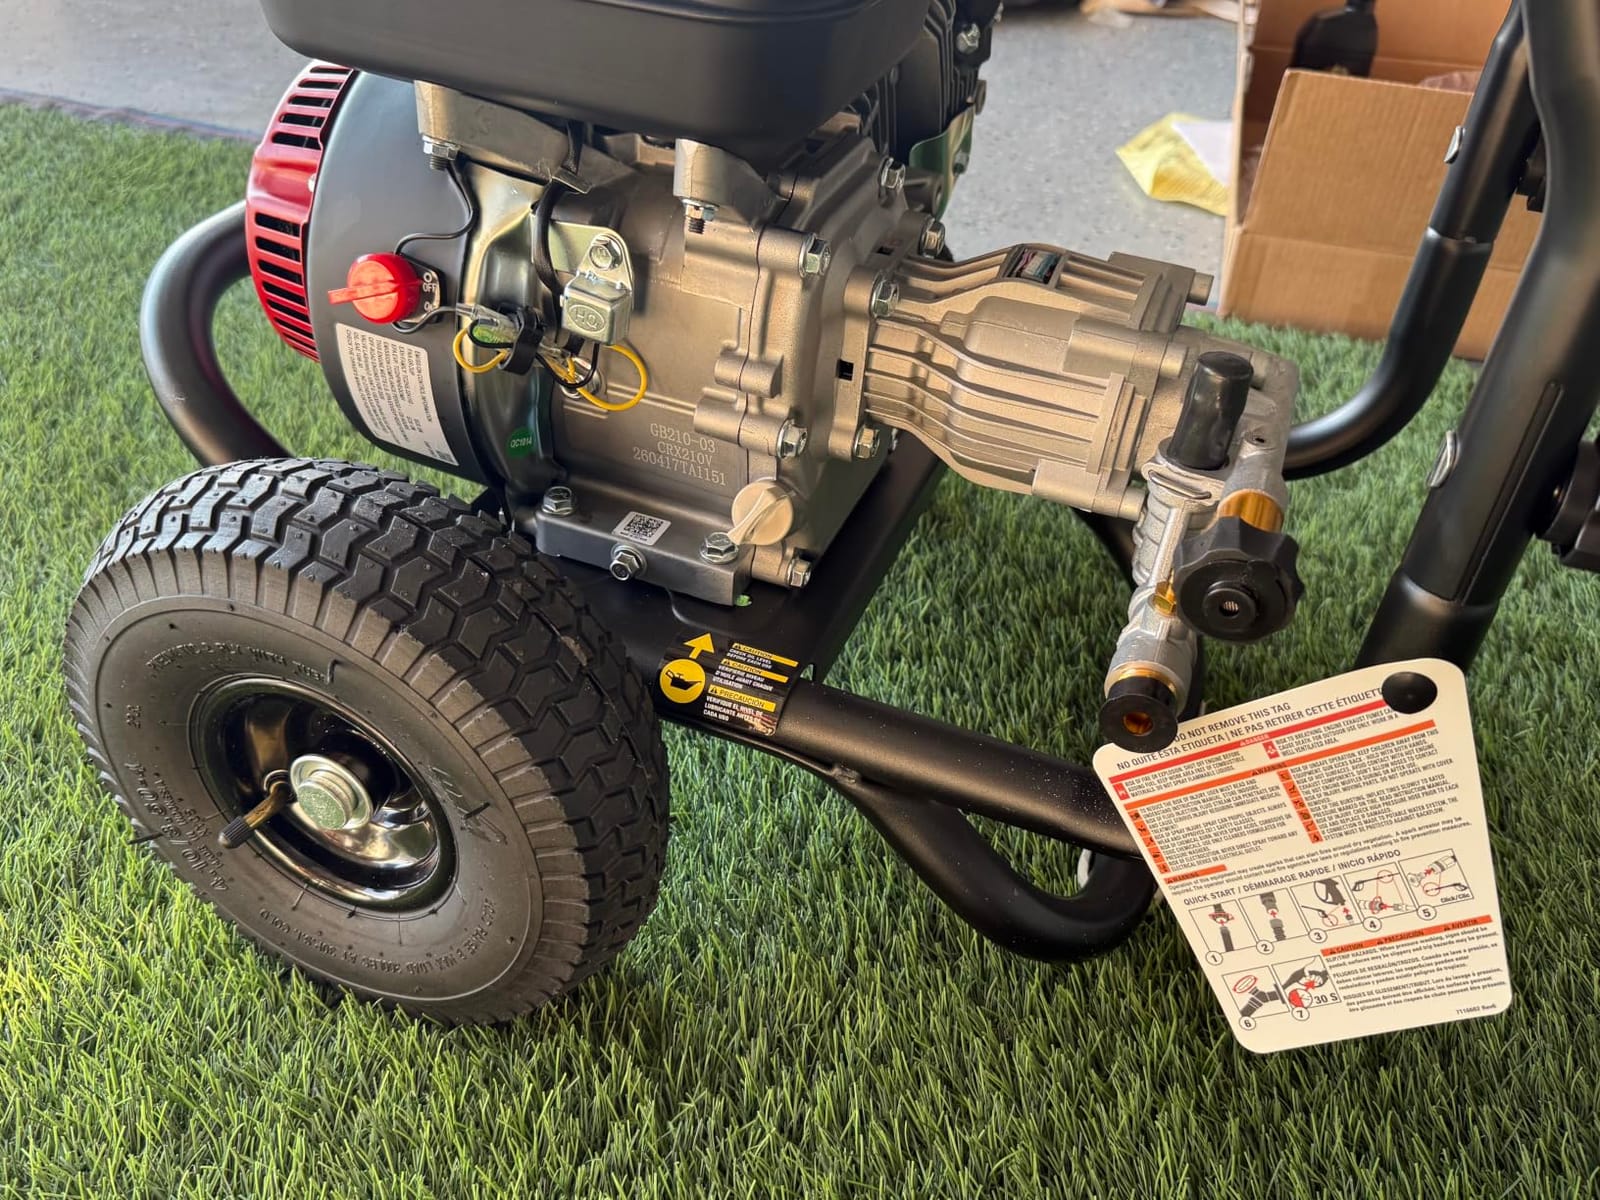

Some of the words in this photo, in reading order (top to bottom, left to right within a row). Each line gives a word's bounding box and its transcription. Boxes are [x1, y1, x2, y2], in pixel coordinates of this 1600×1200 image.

[650, 423, 716, 452] GB210-03
[633, 447, 726, 486] 260417TA1151
[657, 441, 713, 467] CRX210V
[744, 647, 772, 658] CAUTION
[1187, 726, 1207, 738] NOT
[1207, 715, 1246, 732] REMOVE
[1247, 708, 1270, 721] THIS
[1271, 702, 1290, 714] TAG
[1117, 760, 1131, 770] NO
[1130, 753, 1157, 766] QUITE
[1157, 746, 1181, 758] ESTA
[1181, 733, 1224, 751] ETIQUETA
[1230, 728, 1244, 737] NE
[1244, 722, 1264, 733] PAS
[1264, 710, 1304, 727] RETIRER
[1305, 701, 1334, 716] CETTE
[1183, 894, 1209, 905] QUICK
[1210, 888, 1236, 898] START
[1298, 866, 1330, 878] RAPIDE
[1338, 858, 1365, 869] INICIO
[1367, 849, 1400, 862] RÁPIDO
[1336, 942, 1363, 951] CAUTION
[1314, 995, 1329, 1005] 30
[1331, 993, 1338, 1001] S
[1244, 1019, 1251, 1028] 6
